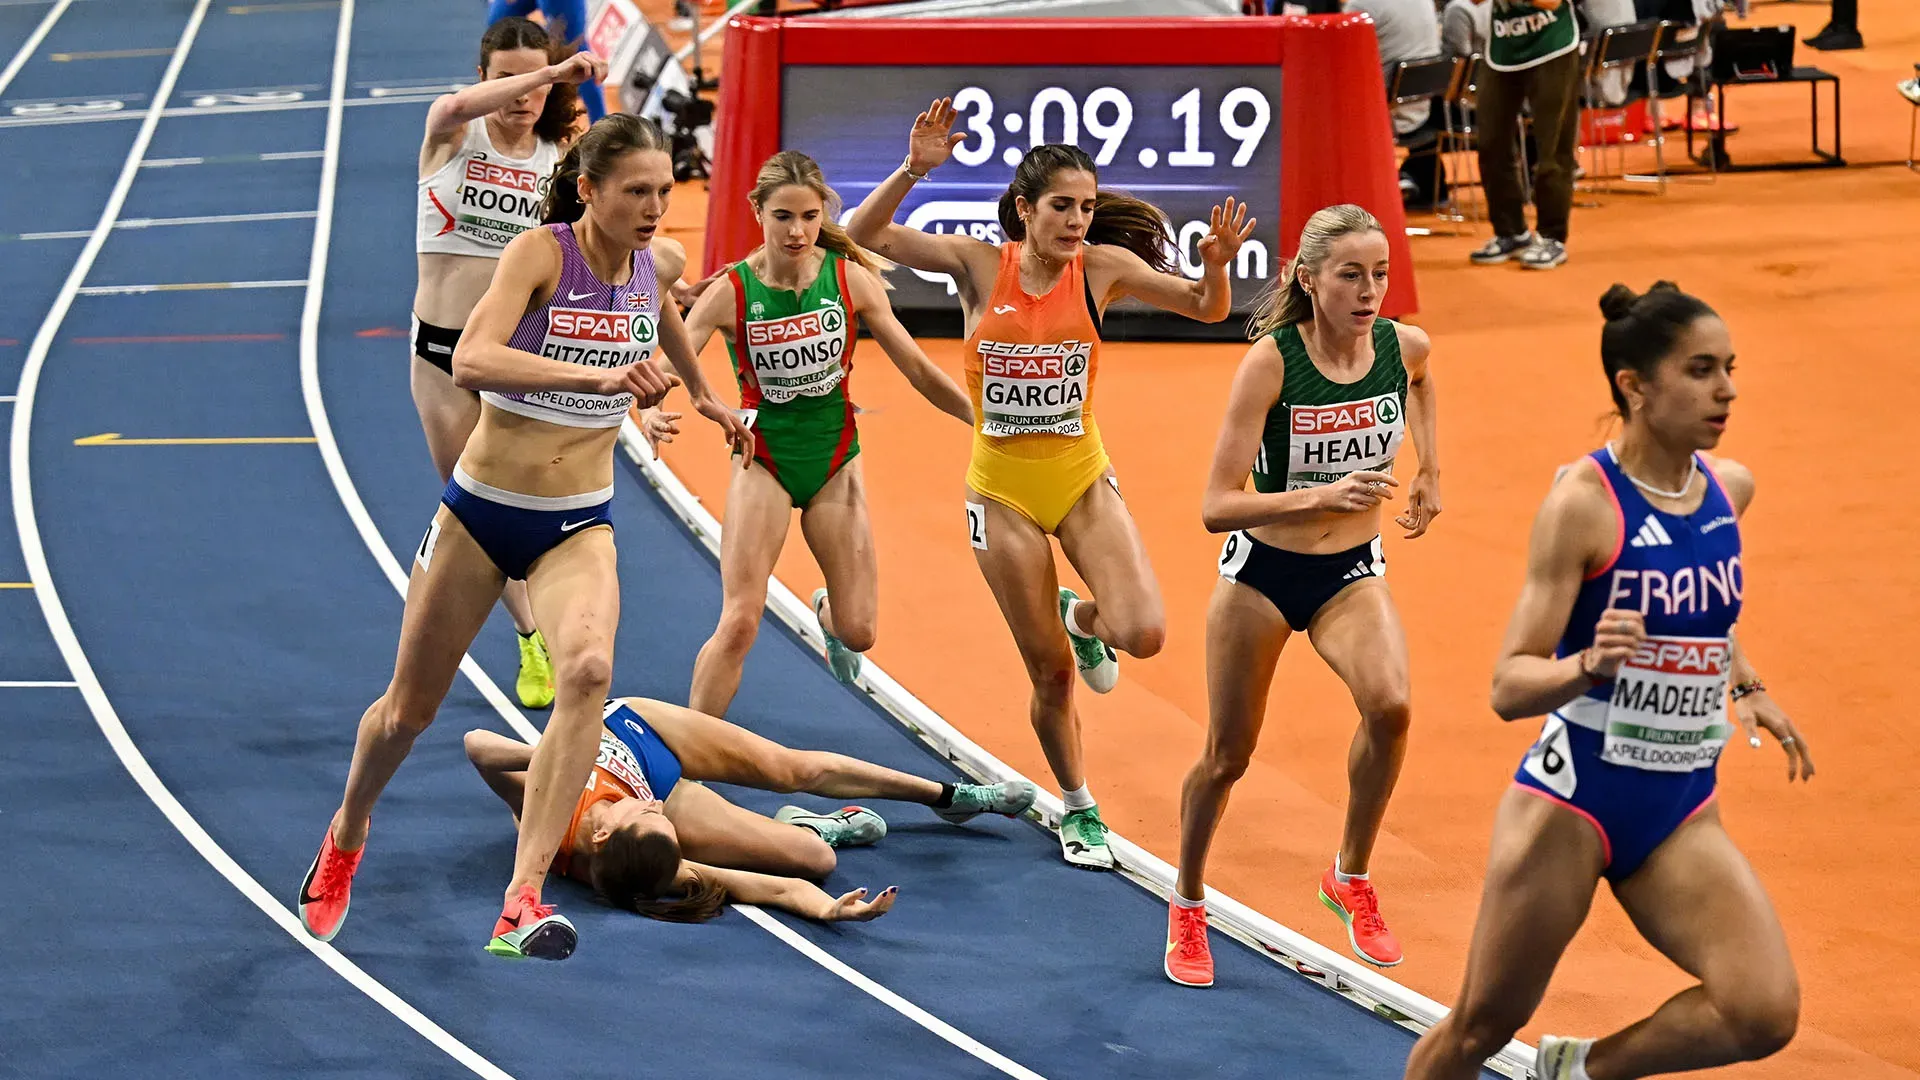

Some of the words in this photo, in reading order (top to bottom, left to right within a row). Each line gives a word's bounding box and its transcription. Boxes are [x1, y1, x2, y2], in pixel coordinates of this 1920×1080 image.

[1493, 10, 1558, 38] DIGITAL
[951, 86, 1271, 168] 3:09.19
[468, 162, 536, 190] SPAR
[458, 225, 514, 244] APELDOO
[480, 218, 500, 229] RUN
[552, 314, 629, 339] SPAR
[750, 317, 820, 343] SPAR
[755, 337, 843, 371] AFONSO
[987, 357, 1062, 376] SPAR
[781, 378, 800, 387] RUN
[985, 377, 1083, 406] GARCÍA
[530, 392, 614, 410] APELDOORN
[1009, 416, 1030, 424] RUN
[1057, 422, 1080, 434] 2025
[1295, 405, 1374, 431] SPAR
[1304, 431, 1393, 464] HEALY
[1319, 473, 1343, 482] RUN
[1221, 534, 1238, 566] 9
[1608, 556, 1743, 618] FRANC
[1631, 641, 1724, 672] SPAR
[1645, 728, 1675, 743] RUN
